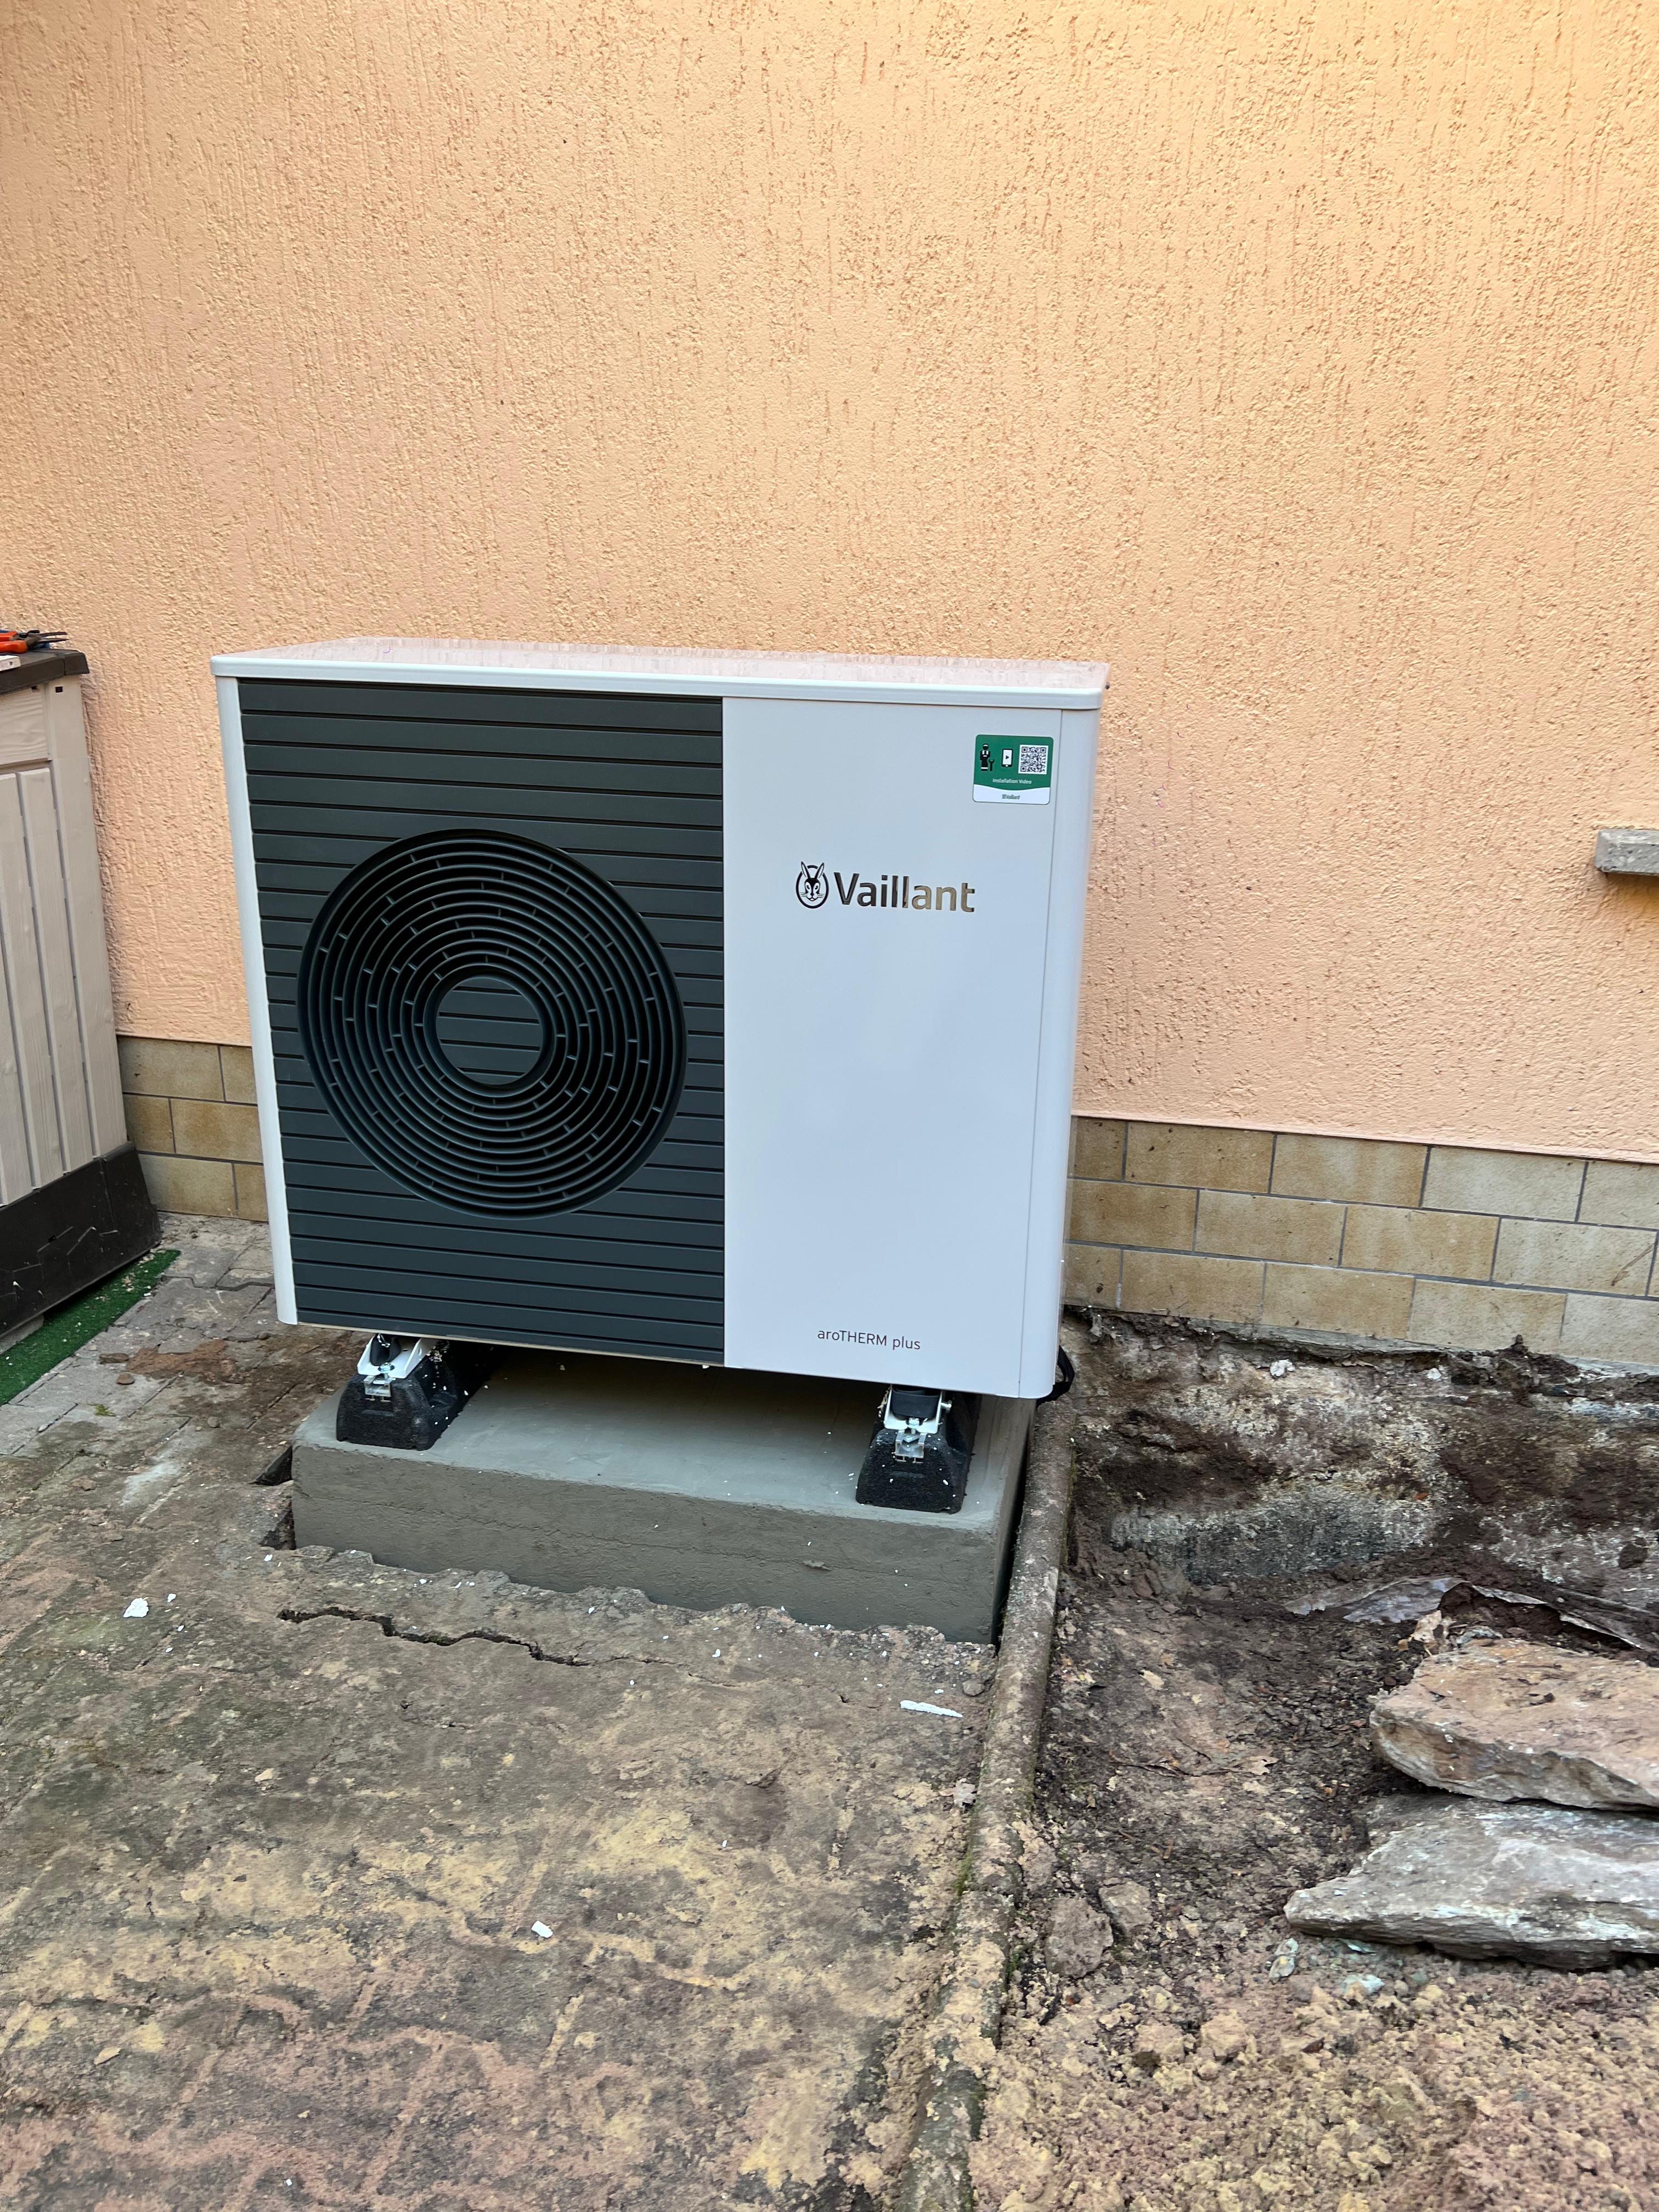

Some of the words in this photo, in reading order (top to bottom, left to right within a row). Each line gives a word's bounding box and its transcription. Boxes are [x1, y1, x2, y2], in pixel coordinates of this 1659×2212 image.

[834, 872, 975, 913] Vaillant
[817, 1330, 887, 1346] aroTHERM
[892, 1336, 921, 1350] plus
